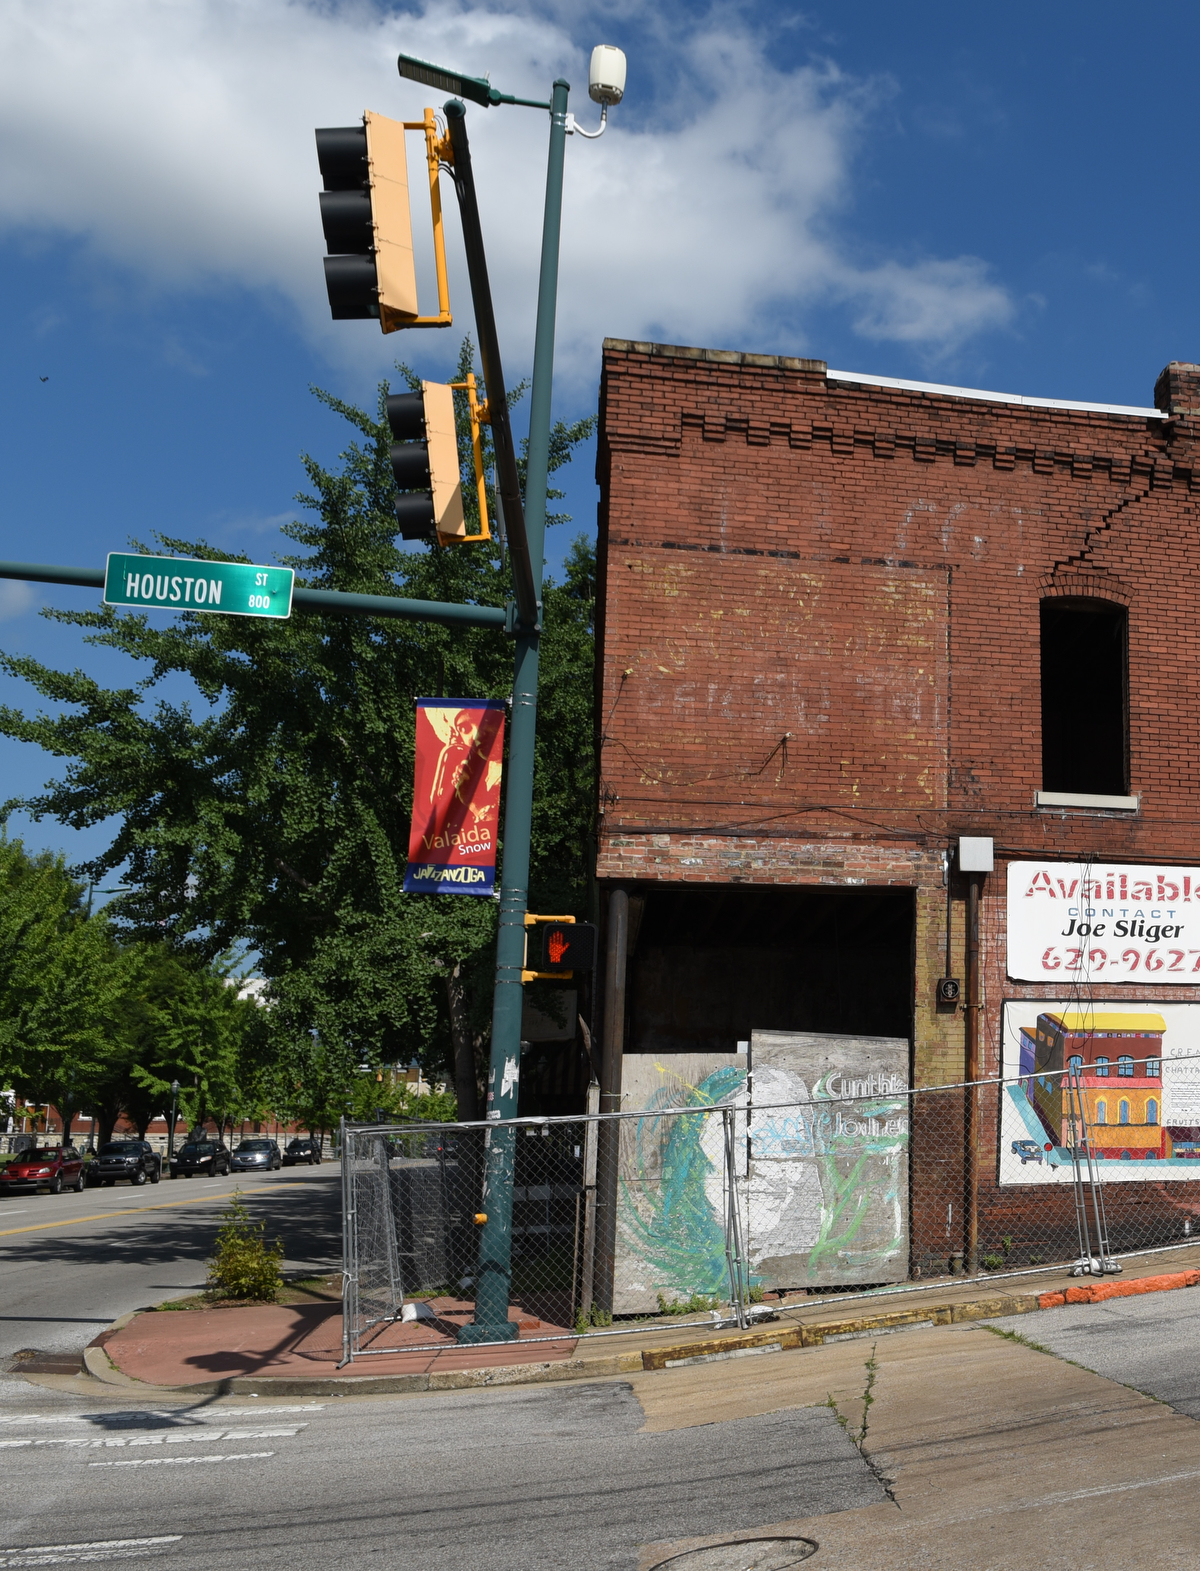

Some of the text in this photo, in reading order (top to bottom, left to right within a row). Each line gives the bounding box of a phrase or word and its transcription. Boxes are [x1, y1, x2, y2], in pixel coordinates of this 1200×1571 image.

[255, 573, 268, 586] ST
[126, 573, 222, 604] HOUSTON
[249, 595, 270, 609] 800
[422, 825, 491, 850] Valaida
[458, 841, 491, 855] Snow
[413, 864, 485, 883] JAZZANOOGA
[1068, 907, 1176, 918] CONTACT
[1061, 919, 1185, 943] Joe Sliger
